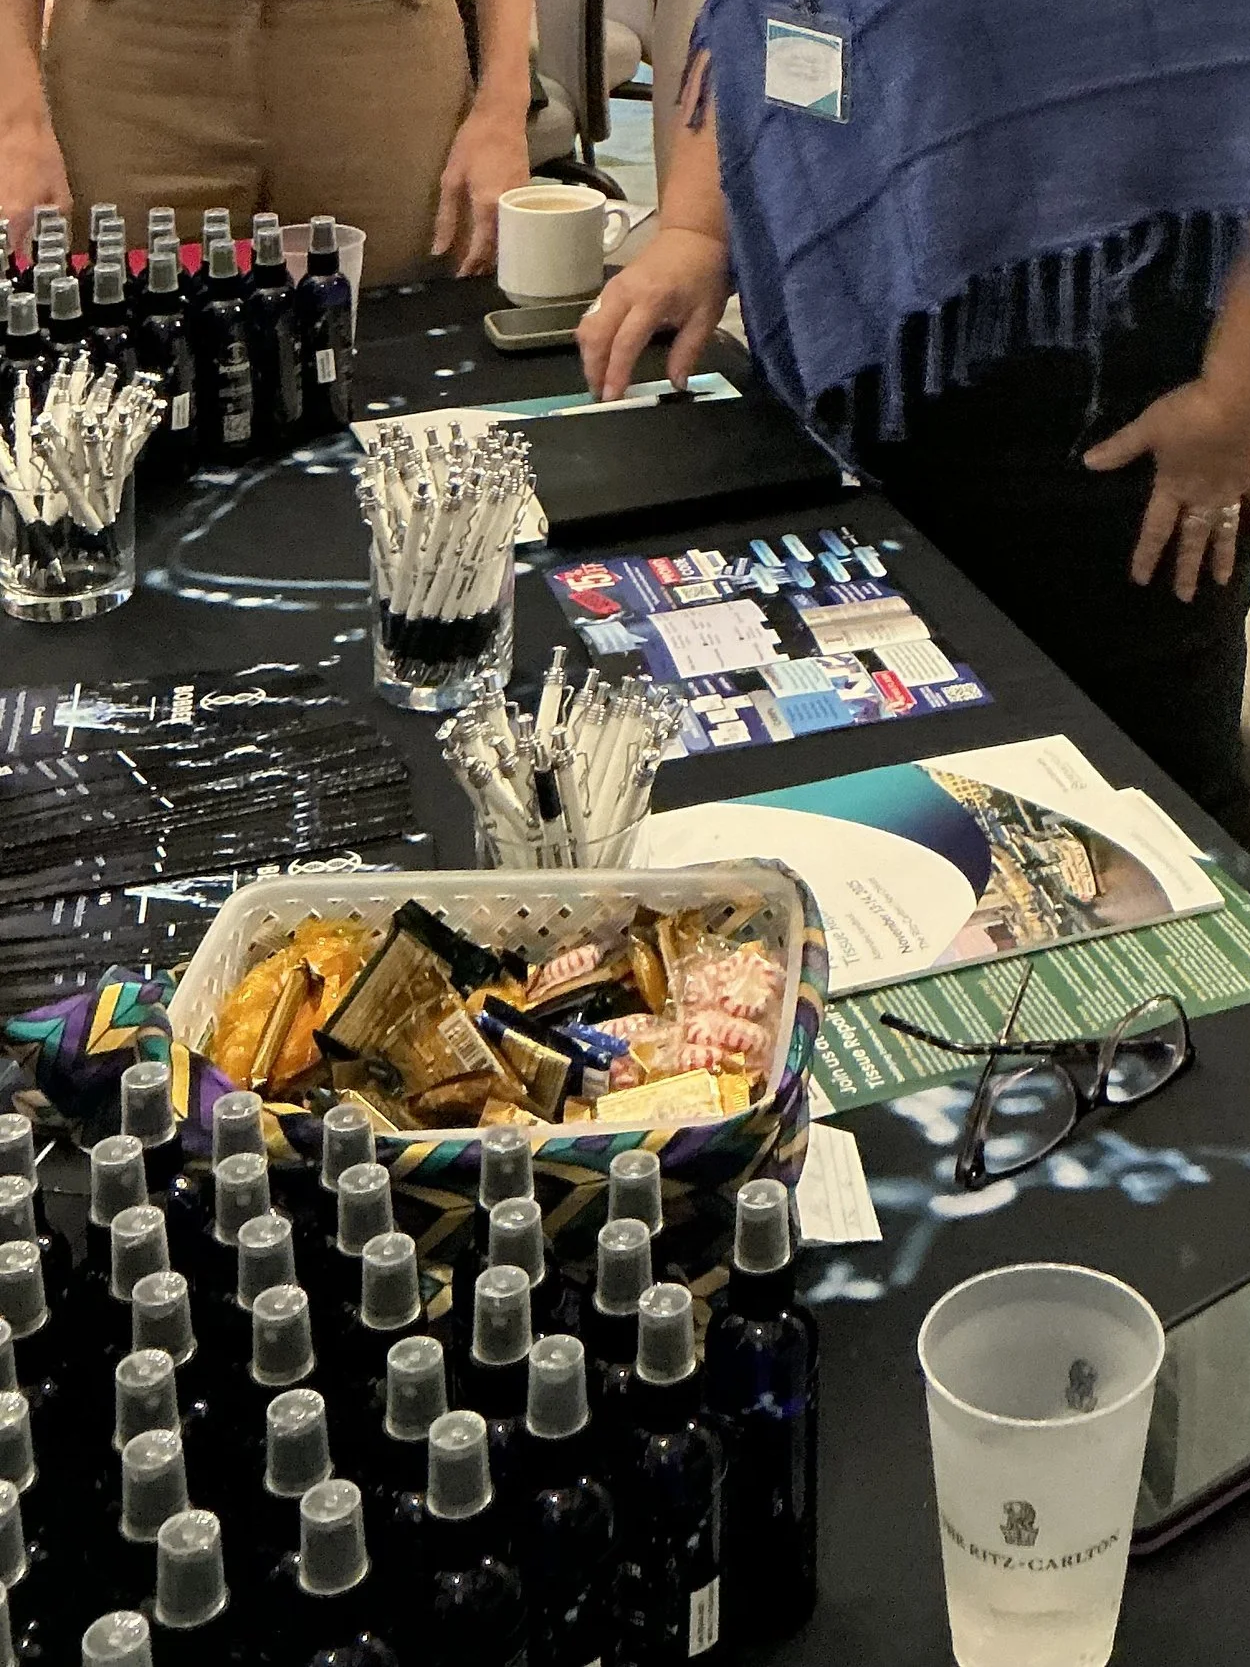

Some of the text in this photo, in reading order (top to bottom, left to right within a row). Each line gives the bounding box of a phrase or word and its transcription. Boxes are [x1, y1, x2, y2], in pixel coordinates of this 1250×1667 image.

[822, 1052, 840, 1070] us
[851, 1049, 885, 1090] Tissue
[831, 1068, 857, 1094] Join
